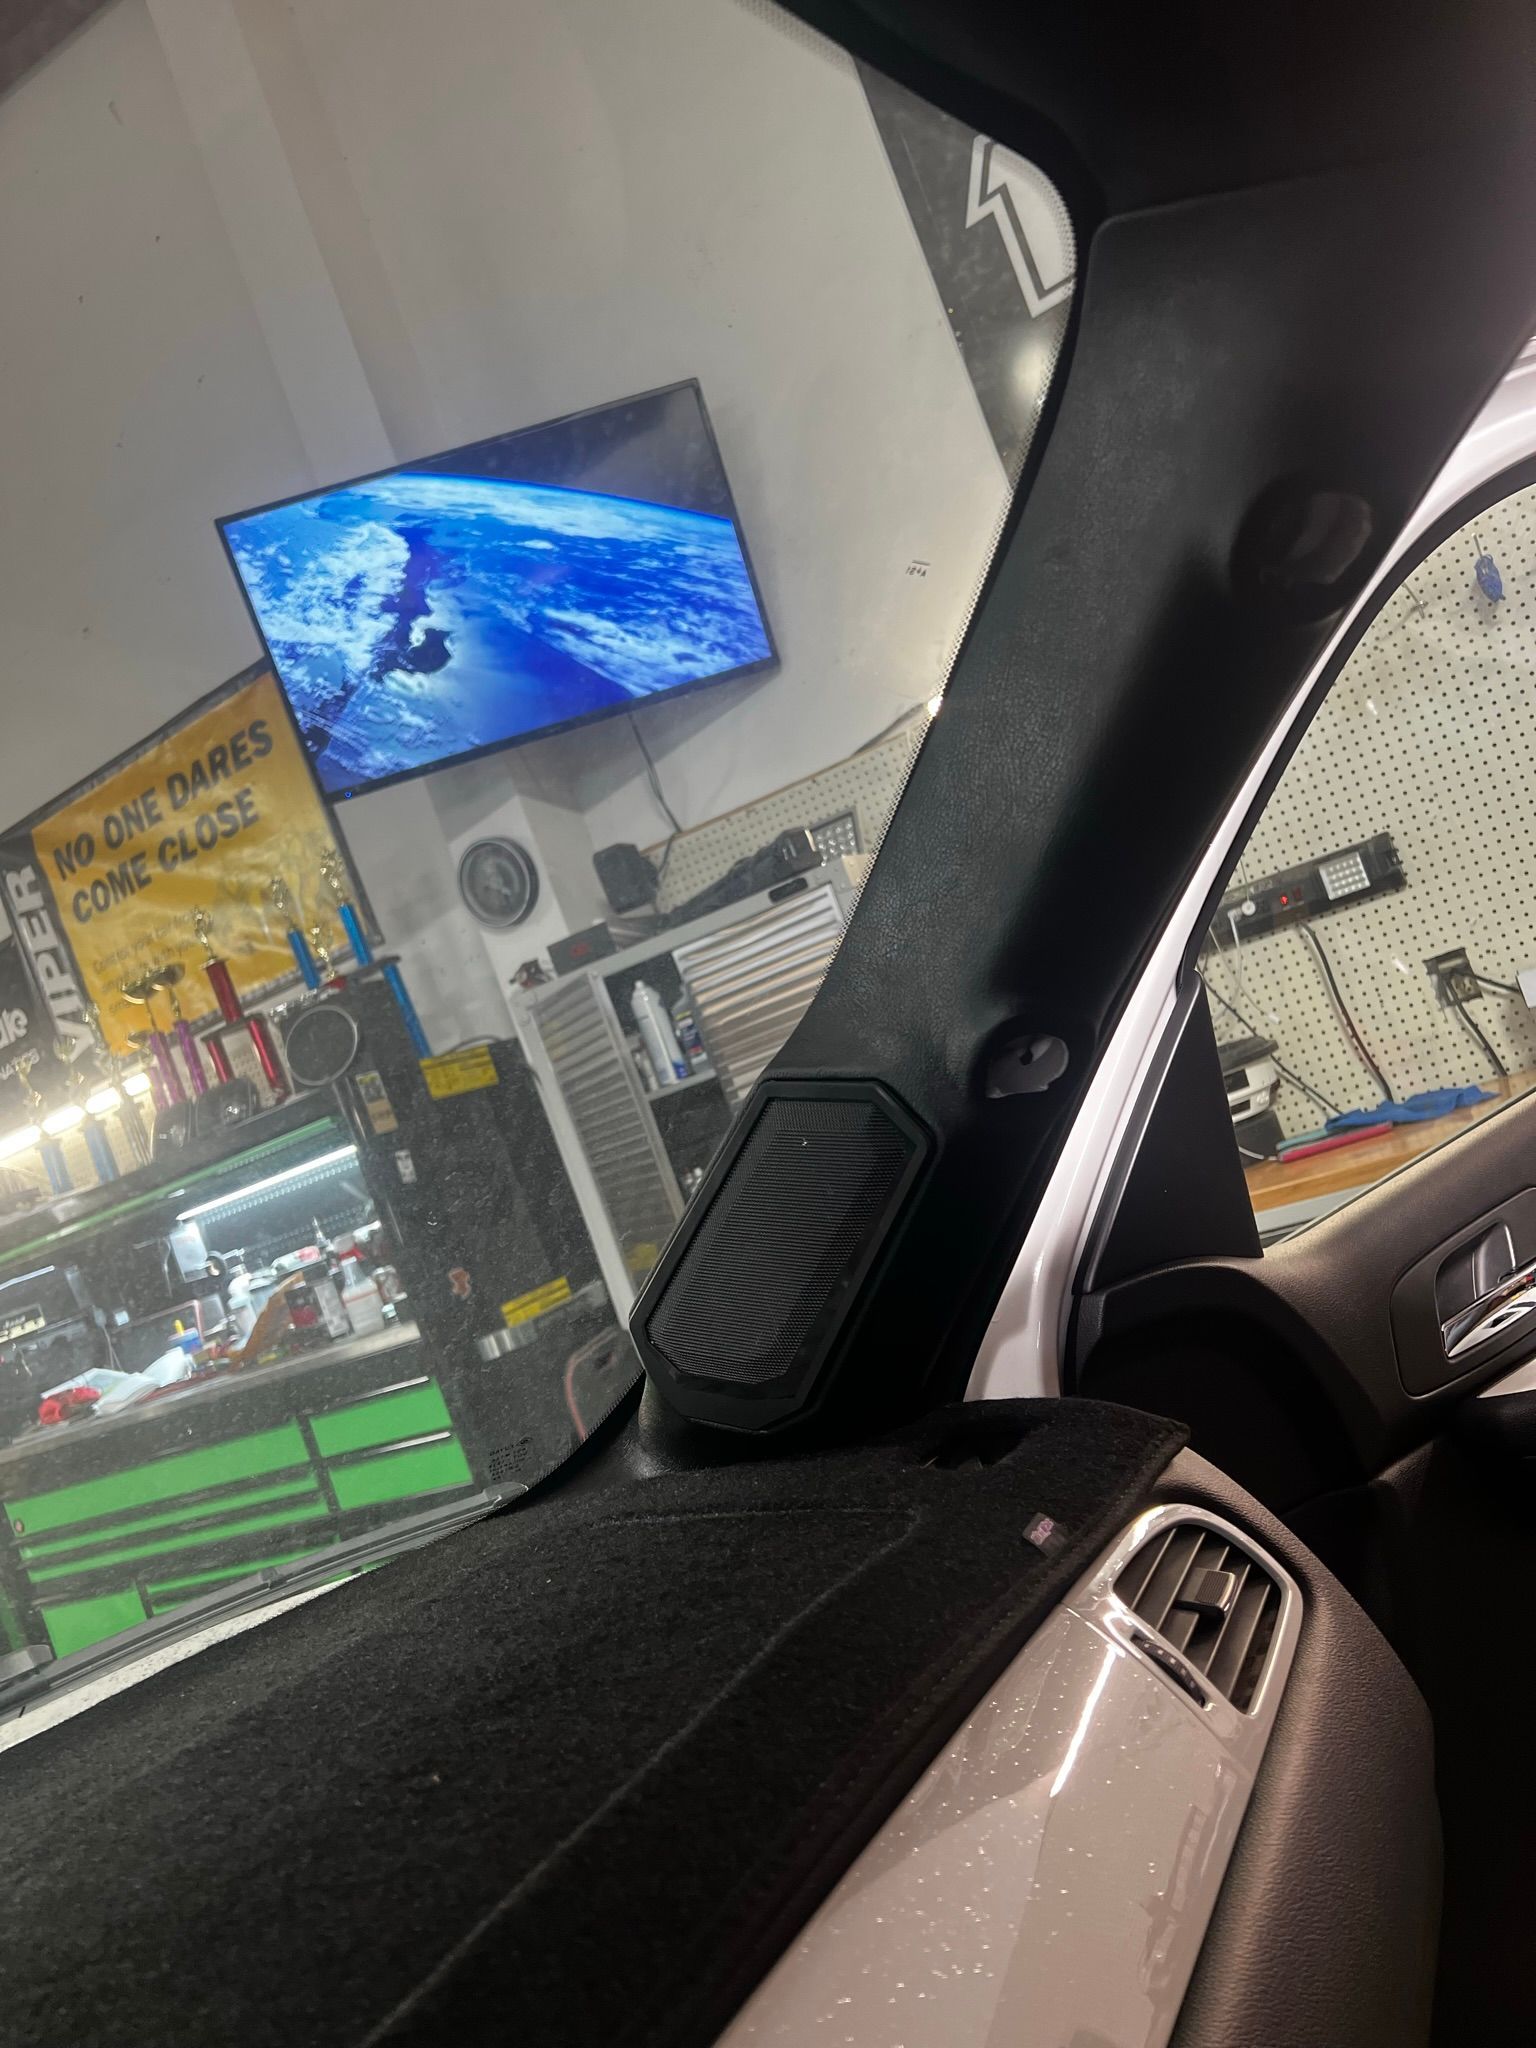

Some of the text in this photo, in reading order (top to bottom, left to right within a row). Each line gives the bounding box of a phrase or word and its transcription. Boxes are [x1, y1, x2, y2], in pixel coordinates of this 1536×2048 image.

[53, 719, 273, 881] NO ONE DARES
[72, 787, 260, 923] COME CLOSE
[6, 864, 95, 1064] VIPER
